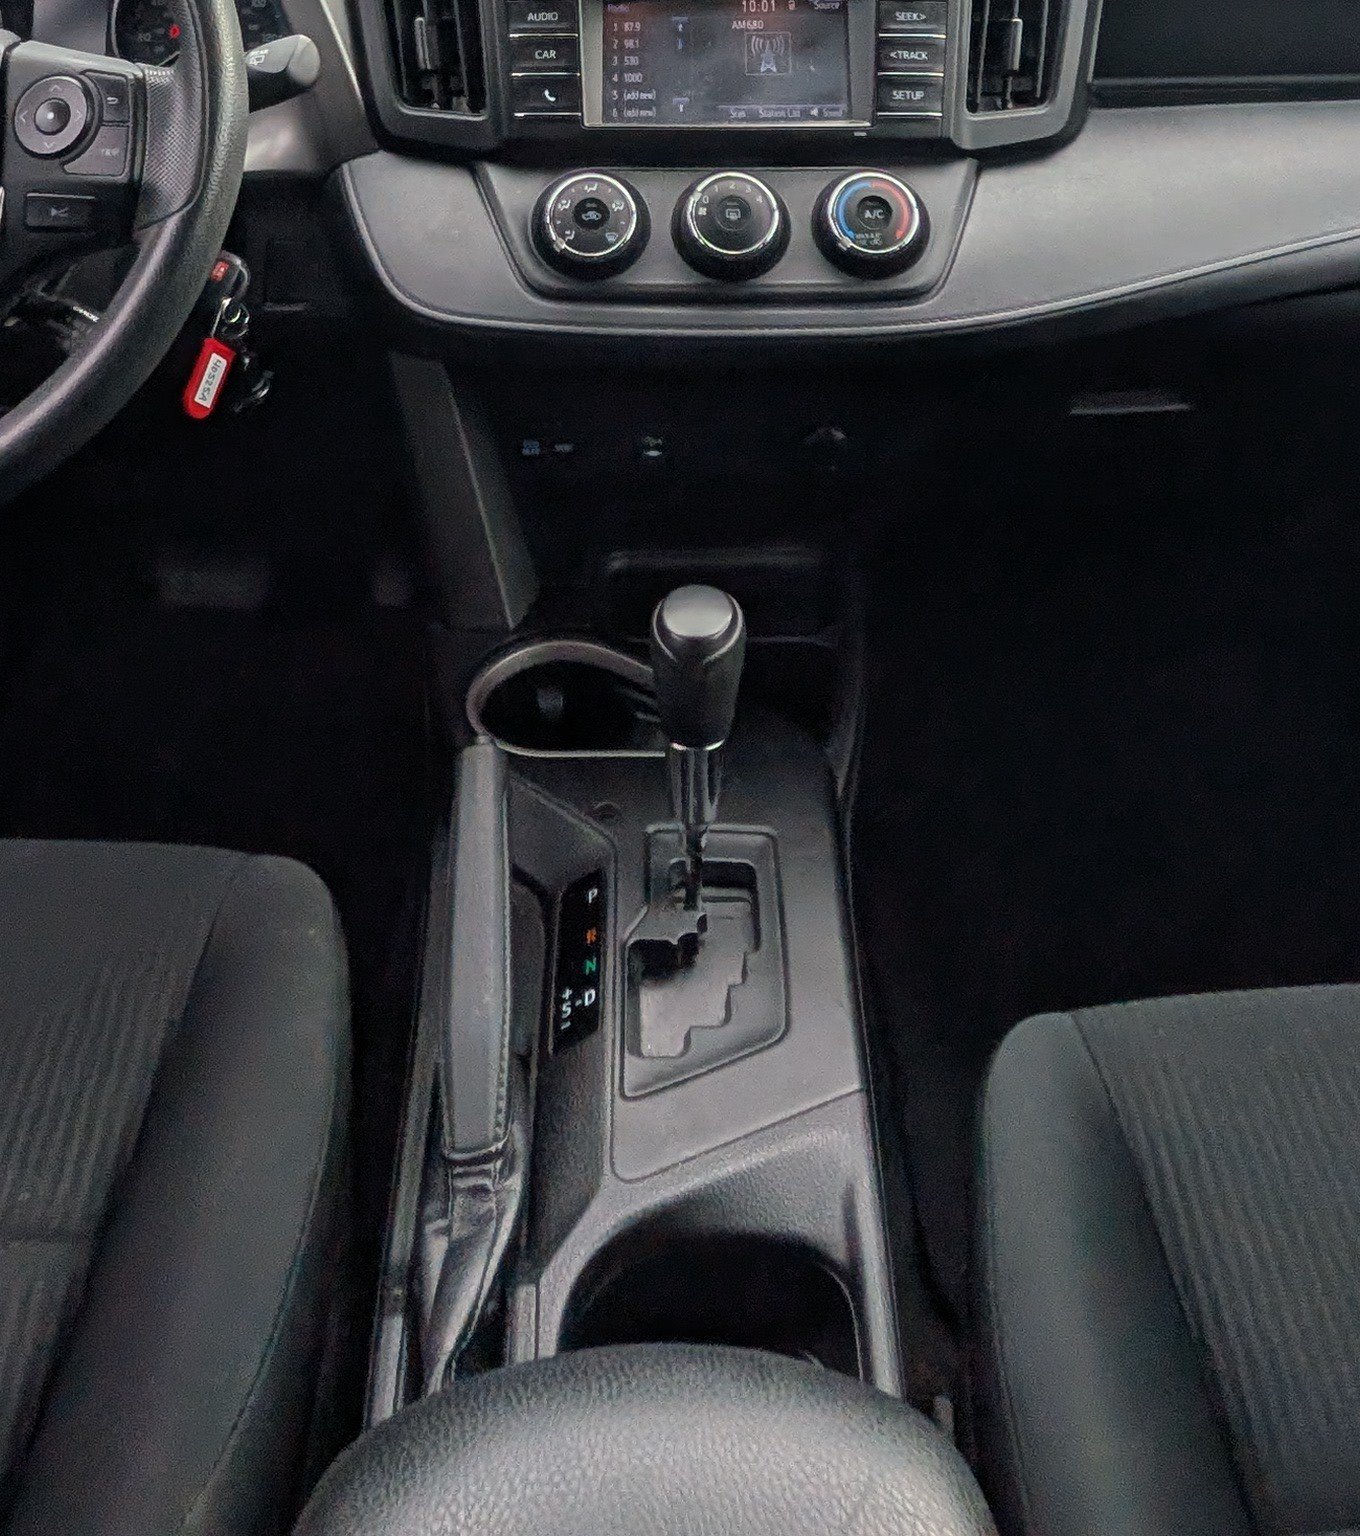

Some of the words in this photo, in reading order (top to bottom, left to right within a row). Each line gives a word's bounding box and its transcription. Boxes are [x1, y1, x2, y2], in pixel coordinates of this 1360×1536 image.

[742, 0, 776, 12] 10:01
[527, 12, 559, 21] AUDIO
[623, 22, 641, 32] 87.9
[535, 50, 557, 59] CAR
[891, 91, 925, 100] SETUP
[864, 209, 884, 220] A/C
[588, 888, 598, 904] P
[586, 926, 597, 945] R
[584, 956, 597, 976] N
[584, 988, 596, 1007] D
[561, 1000, 572, 1019] S
